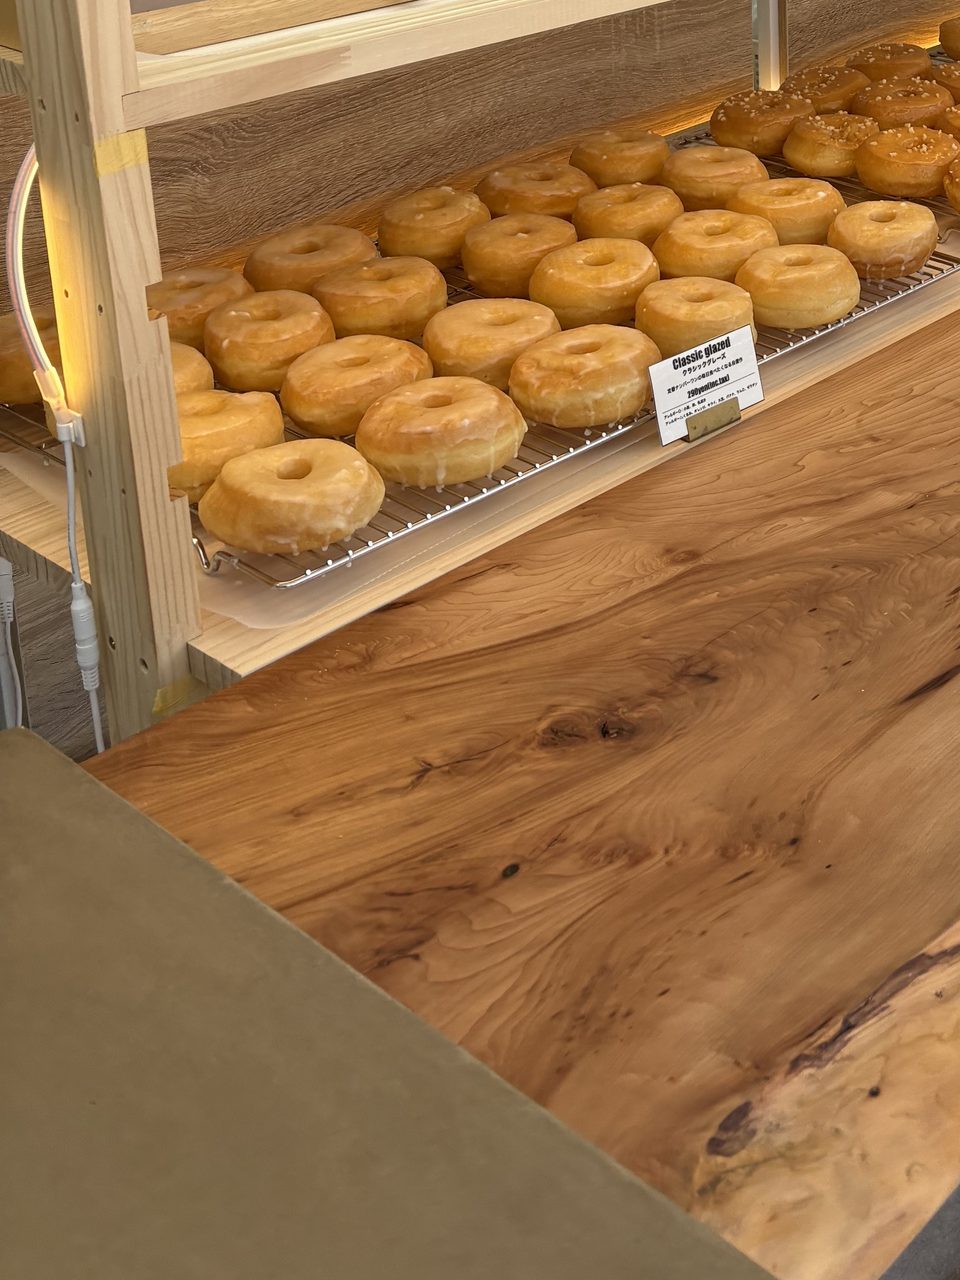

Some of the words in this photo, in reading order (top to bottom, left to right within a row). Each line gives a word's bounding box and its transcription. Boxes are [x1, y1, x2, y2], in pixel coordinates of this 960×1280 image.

[672, 349, 704, 370] Classic
[704, 336, 732, 358] glazed
[682, 352, 727, 377] クラシックグレーズ
